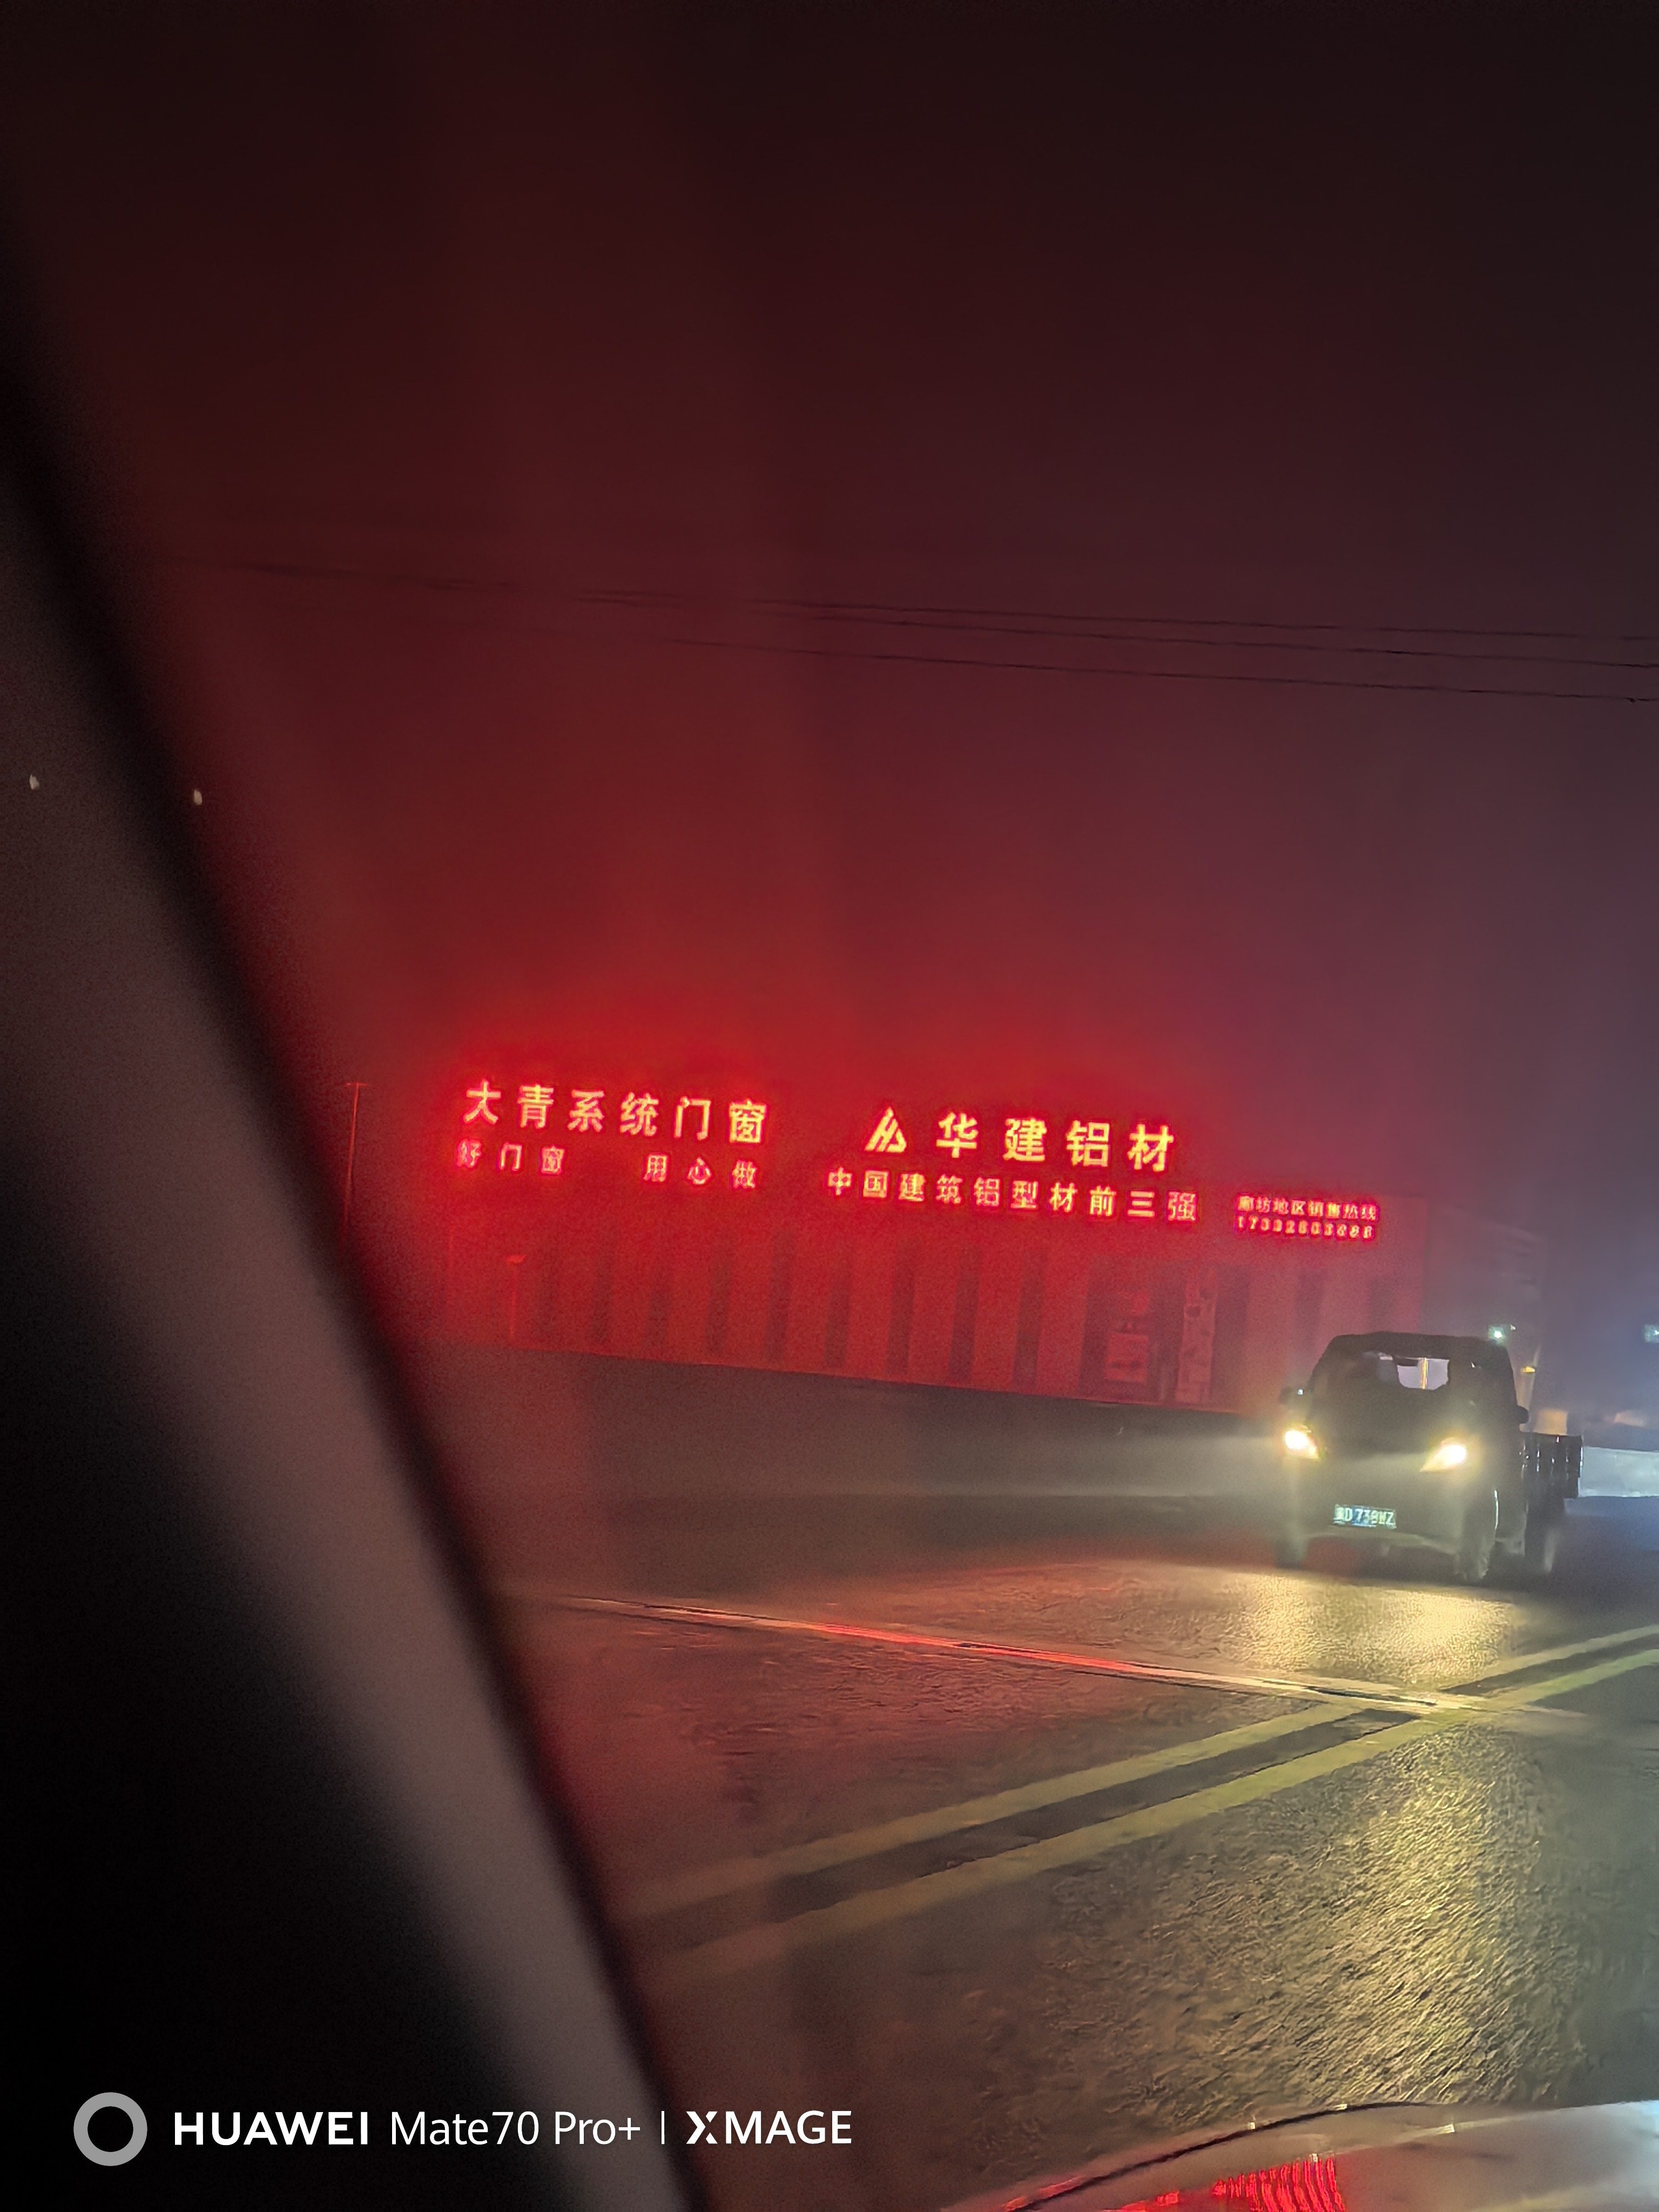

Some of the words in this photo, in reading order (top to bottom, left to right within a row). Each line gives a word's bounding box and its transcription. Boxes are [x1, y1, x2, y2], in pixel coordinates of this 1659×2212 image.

[464, 1081, 767, 1144] 大青系统门窗
[456, 1139, 565, 1175] 好门窗
[644, 1154, 759, 1189] 用心做
[936, 1112, 1175, 1172] 华建铝材
[828, 1168, 1198, 1221] 中国建筑铝型材前三强
